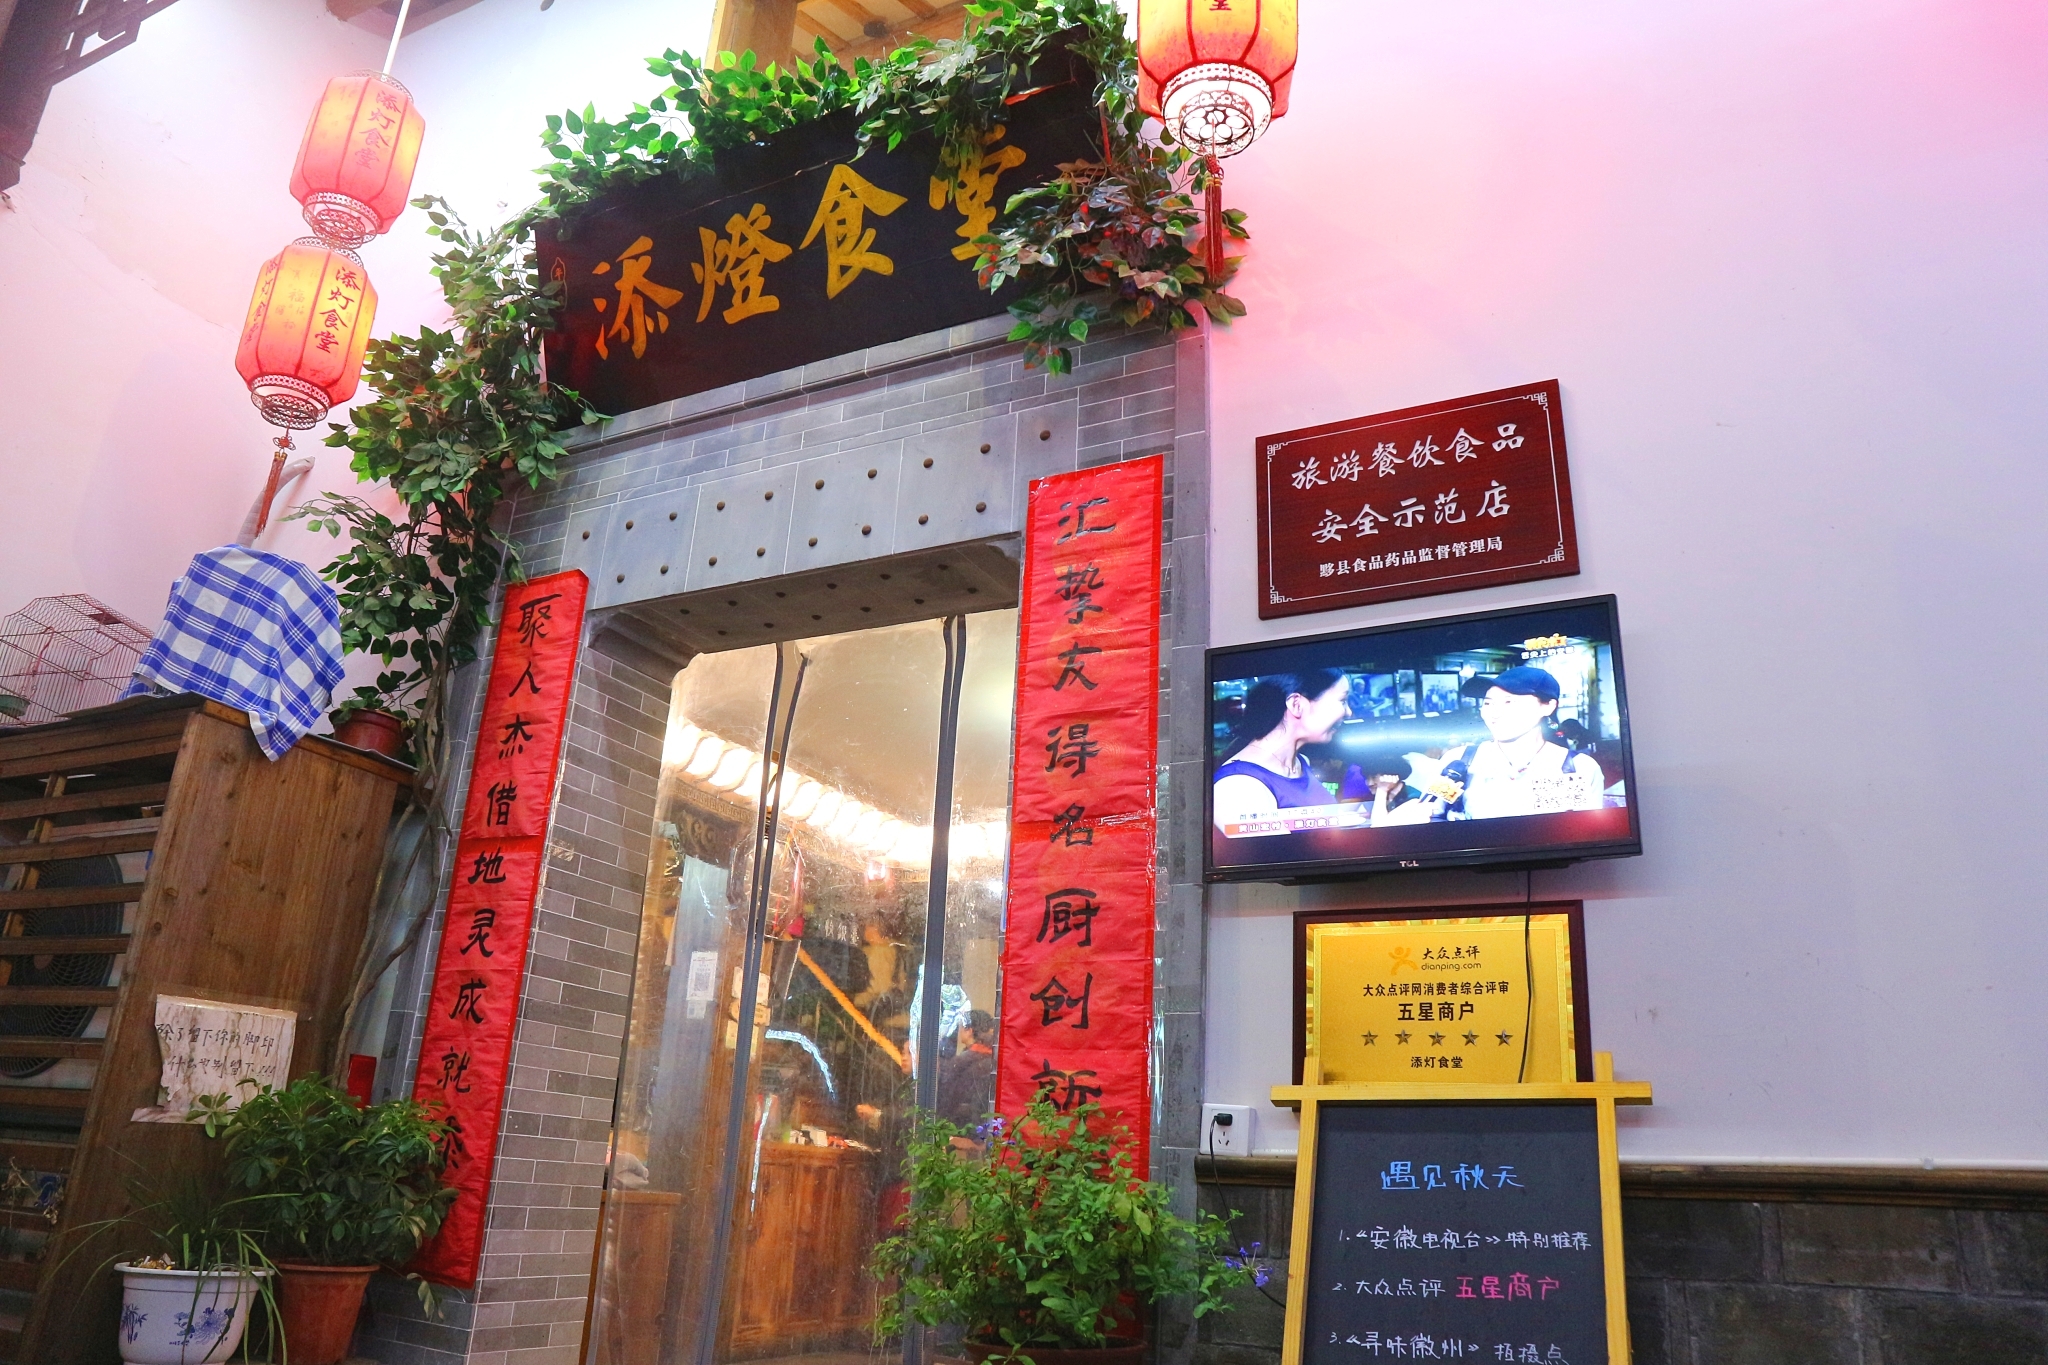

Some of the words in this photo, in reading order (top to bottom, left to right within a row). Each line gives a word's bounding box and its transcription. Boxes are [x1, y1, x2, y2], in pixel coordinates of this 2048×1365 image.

[355, 90, 402, 170] 添灯食堂
[592, 123, 1027, 361] 添燈食堂
[315, 266, 362, 354] 添灯食堂
[1291, 423, 1525, 490] 旅游餐饮食品
[1311, 479, 1511, 543] 安全示范店
[1319, 536, 1503, 578] 黟县食品药品监督管理局
[1400, 860, 1419, 868] TCL
[1421, 961, 1482, 972] dianping.com
[1422, 945, 1481, 960] 大众点评
[1363, 981, 1510, 997] 大众点评网消费者综合评审
[1397, 1001, 1475, 1022] 五星商户
[1411, 1056, 1463, 1069] 添灯食堂
[1381, 1160, 1525, 1190] 遇见秋天
[1456, 1272, 1560, 1302] 五星商户
